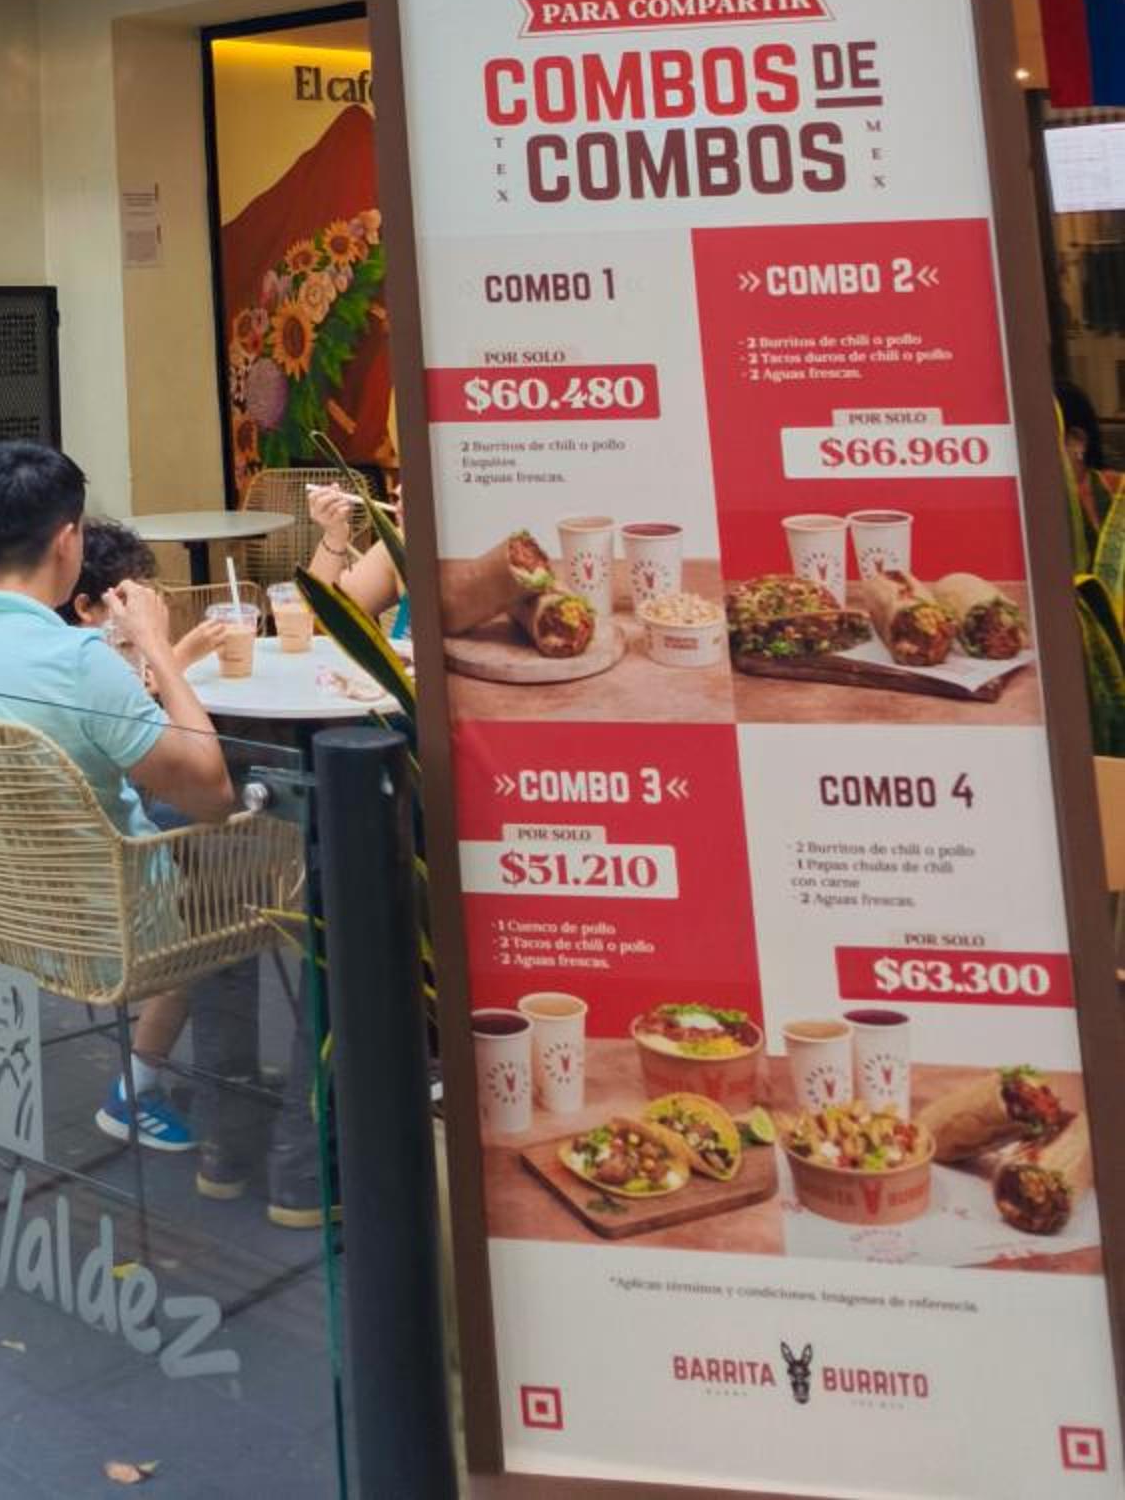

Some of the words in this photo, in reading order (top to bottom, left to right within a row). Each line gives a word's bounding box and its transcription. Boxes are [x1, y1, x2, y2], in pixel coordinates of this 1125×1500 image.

[295, 65, 321, 101] El
[483, 43, 800, 126] COMBOS
[812, 41, 881, 92] DE
[526, 122, 847, 203] COMBOS
[485, 272, 592, 303] COMBO
[602, 268, 616, 301] 1
[767, 263, 881, 297] COMBO
[891, 257, 915, 293] 2
[484, 350, 519, 364] POR
[523, 350, 566, 364] SOLO
[819, 335, 837, 348] de
[464, 375, 645, 414] $60.480
[849, 412, 882, 425] POR
[884, 411, 928, 425] SOLO
[818, 436, 990, 470] $66.960
[519, 769, 629, 803] COMBO
[639, 767, 662, 804] 3
[820, 775, 937, 808] COMBO
[950, 772, 975, 809] 4
[518, 827, 548, 841] POR
[551, 828, 591, 842] SOLO
[869, 842, 888, 855] de
[499, 851, 659, 888] $51.210
[904, 933, 938, 947] POR
[941, 934, 985, 947] SOLO
[873, 957, 1050, 996] $63.300
[673, 1355, 776, 1388] BARRITA
[822, 1367, 930, 1398] BURRITO
